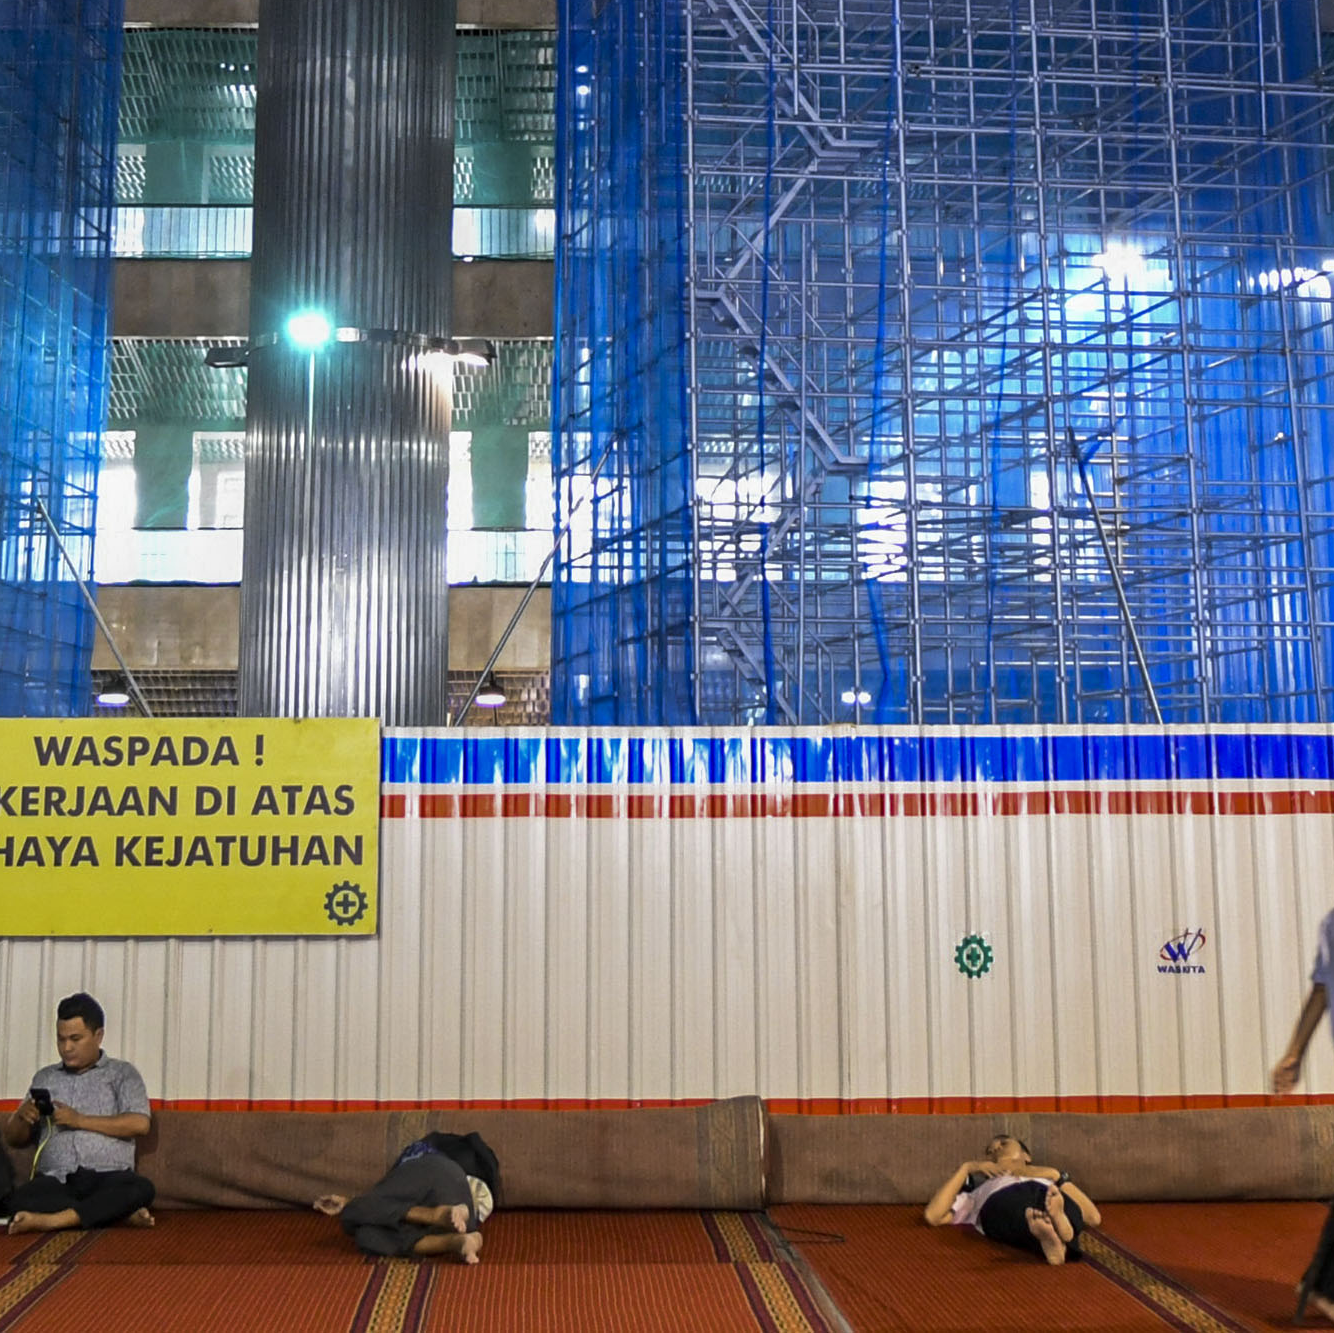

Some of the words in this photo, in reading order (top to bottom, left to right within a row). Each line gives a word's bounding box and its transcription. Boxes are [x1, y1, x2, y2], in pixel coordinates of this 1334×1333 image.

[34, 735, 239, 767] WASPADA
[254, 734, 265, 767] !
[195, 785, 237, 816] DI
[251, 784, 356, 816] ATAS
[114, 835, 364, 868] KEJATUHAN
[1157, 965, 1206, 974] WASKITA
